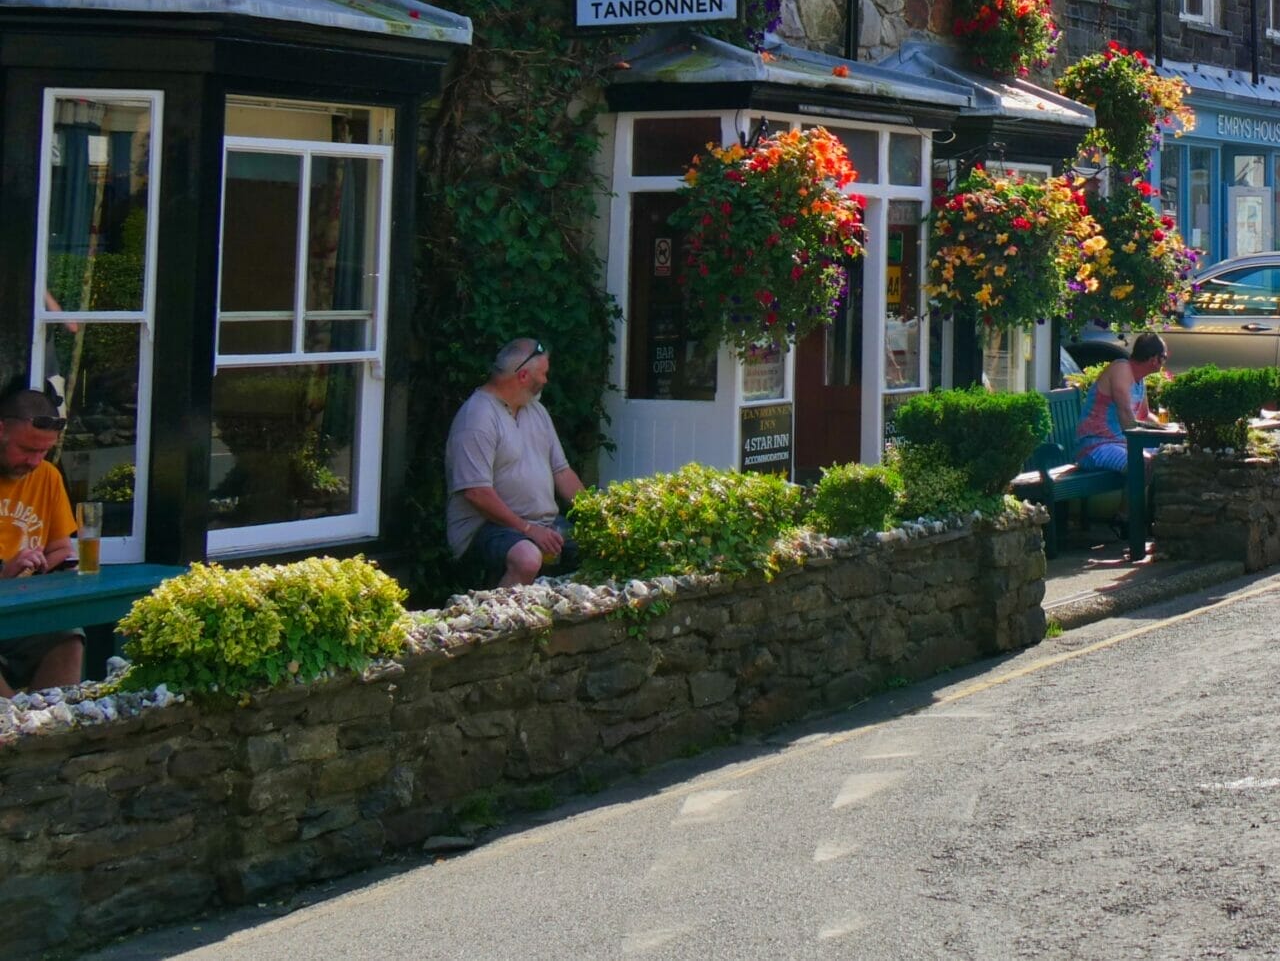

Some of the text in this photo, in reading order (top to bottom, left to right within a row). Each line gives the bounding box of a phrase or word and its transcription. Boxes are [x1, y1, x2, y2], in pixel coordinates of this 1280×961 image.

[1217, 114, 1252, 139] EMRYS
[656, 346, 674, 360] BAR
[653, 359, 677, 374] OPEN
[759, 419, 777, 431] INN
[744, 433, 790, 452] 4 STAR INN
